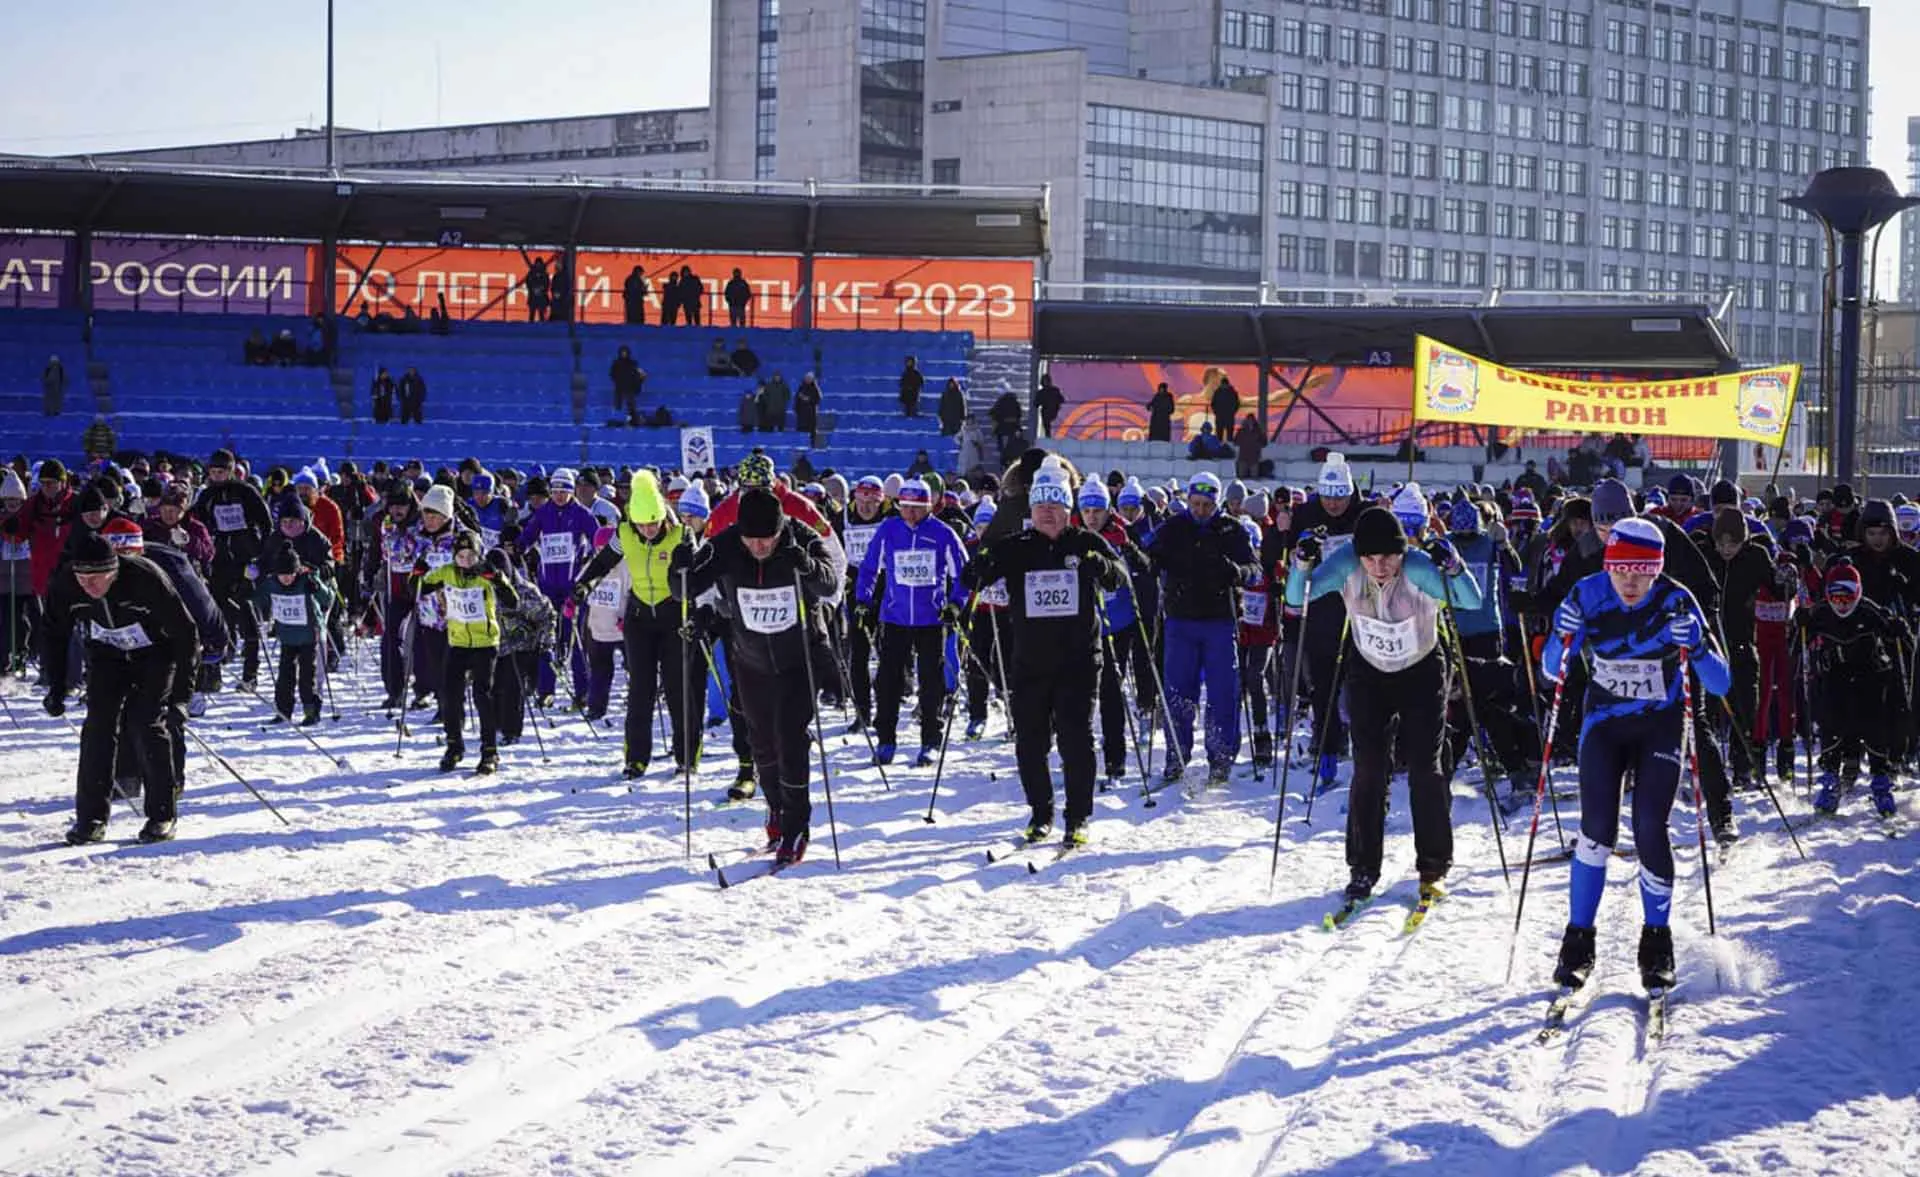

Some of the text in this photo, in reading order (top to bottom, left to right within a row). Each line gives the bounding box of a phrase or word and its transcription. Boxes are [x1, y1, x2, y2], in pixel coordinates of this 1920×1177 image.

[90, 261, 292, 299] РОССИИ
[892, 282, 1014, 317] 2023
[902, 566, 929, 578] 3939
[1034, 589, 1071, 606] 3262
[751, 607, 789, 622] 7772
[1367, 633, 1404, 652] 7331
[1607, 678, 1653, 697] 2171
